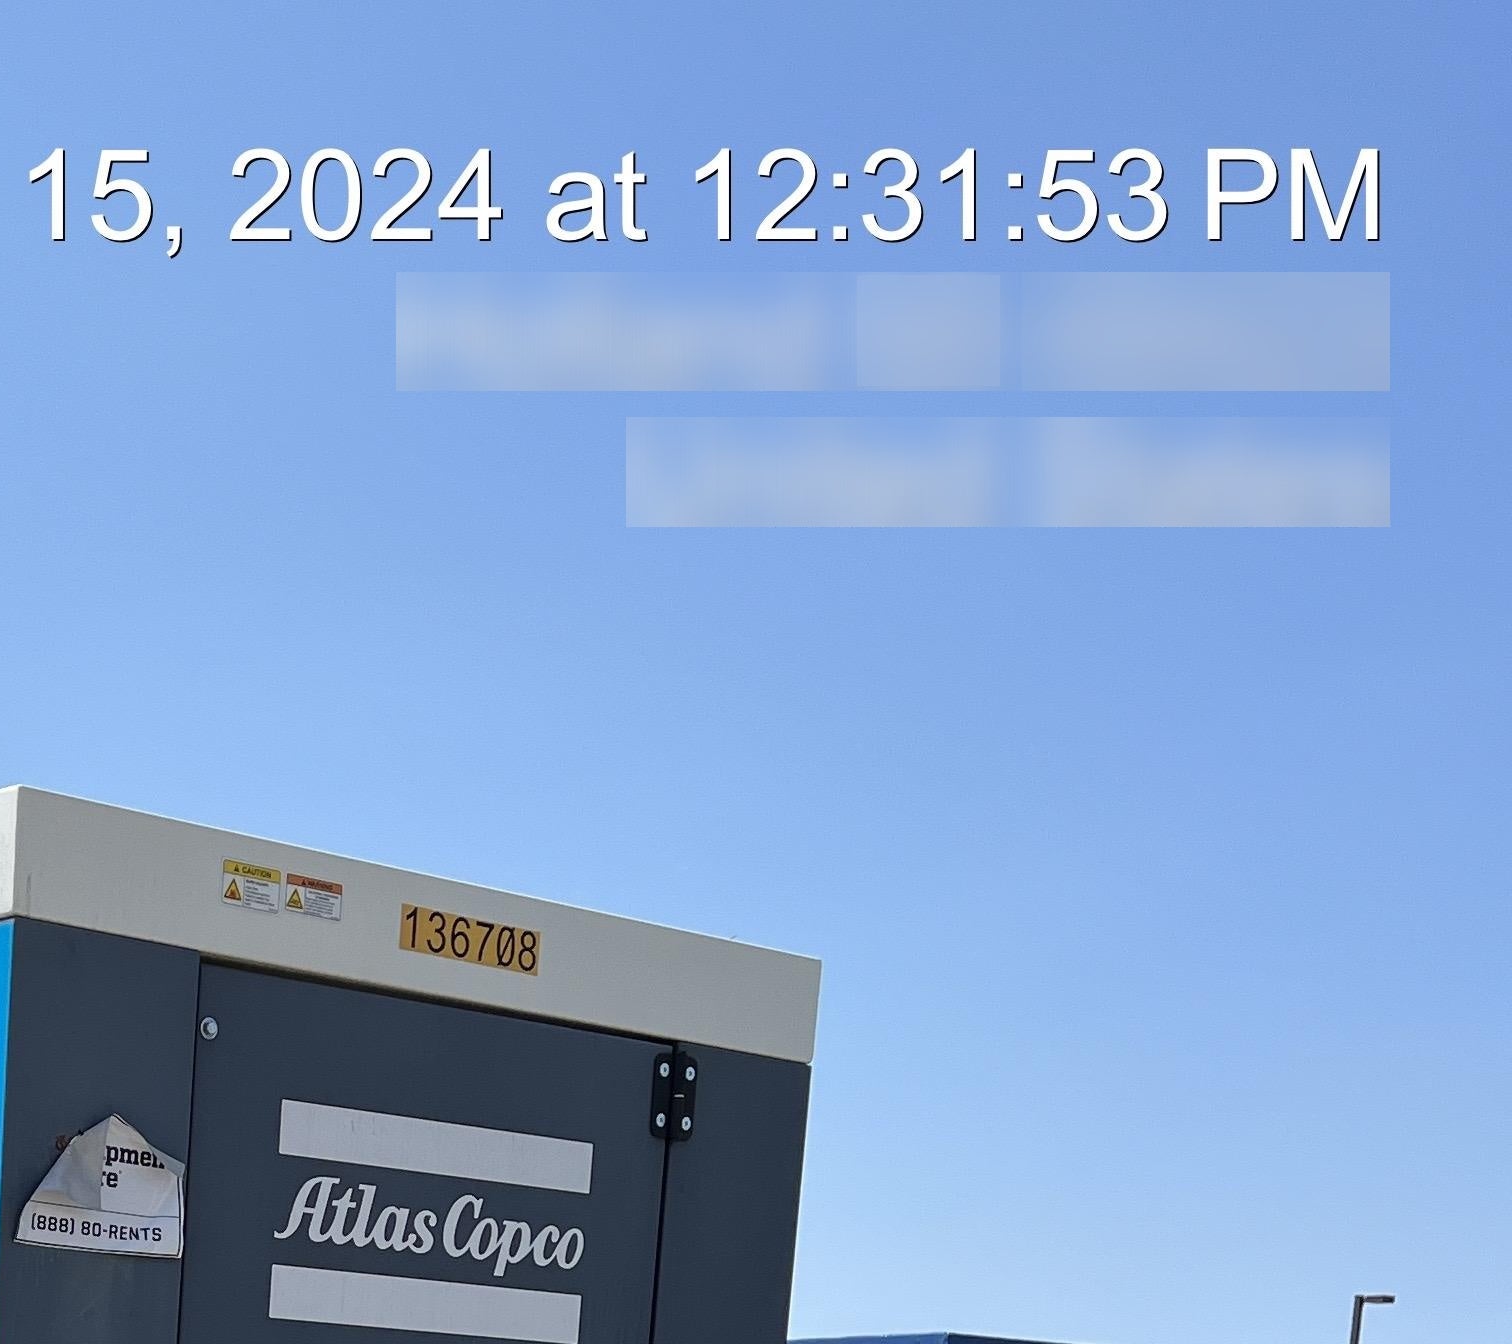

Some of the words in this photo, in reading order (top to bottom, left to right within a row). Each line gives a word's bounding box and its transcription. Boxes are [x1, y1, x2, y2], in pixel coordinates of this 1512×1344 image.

[242, 865, 272, 879] CAUTION
[405, 906, 537, 972] 136708
[31, 1212, 75, 1235] (888)
[81, 1221, 162, 1242] 80-RENTS
[273, 1176, 438, 1255] Atlas
[442, 1194, 585, 1277] Copco
